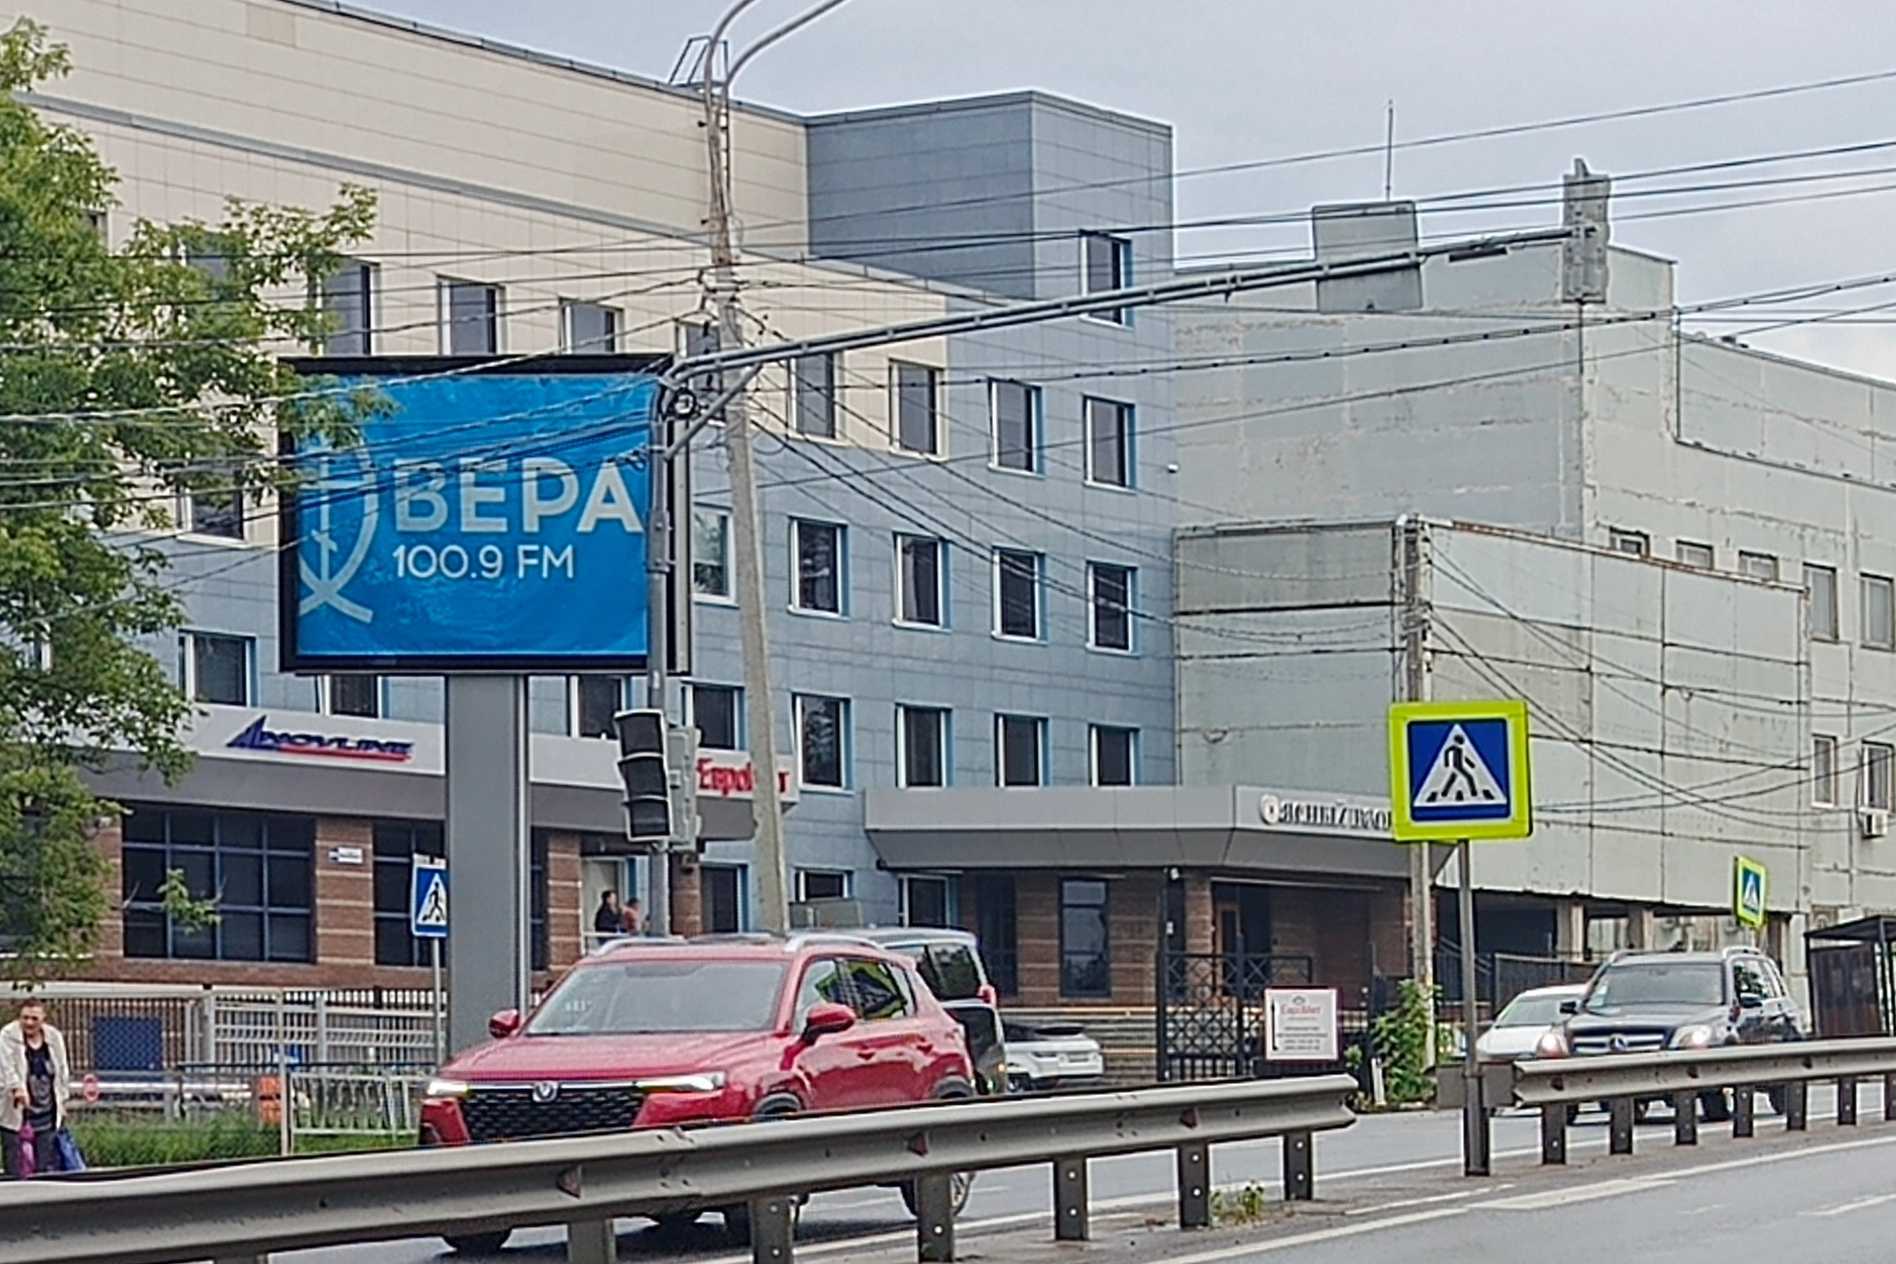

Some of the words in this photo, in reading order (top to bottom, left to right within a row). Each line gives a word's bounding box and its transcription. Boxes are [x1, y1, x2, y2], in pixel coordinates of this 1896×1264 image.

[394, 456, 644, 533] ВЕРА
[393, 544, 502, 579] 100.9
[517, 544, 574, 579] FM
